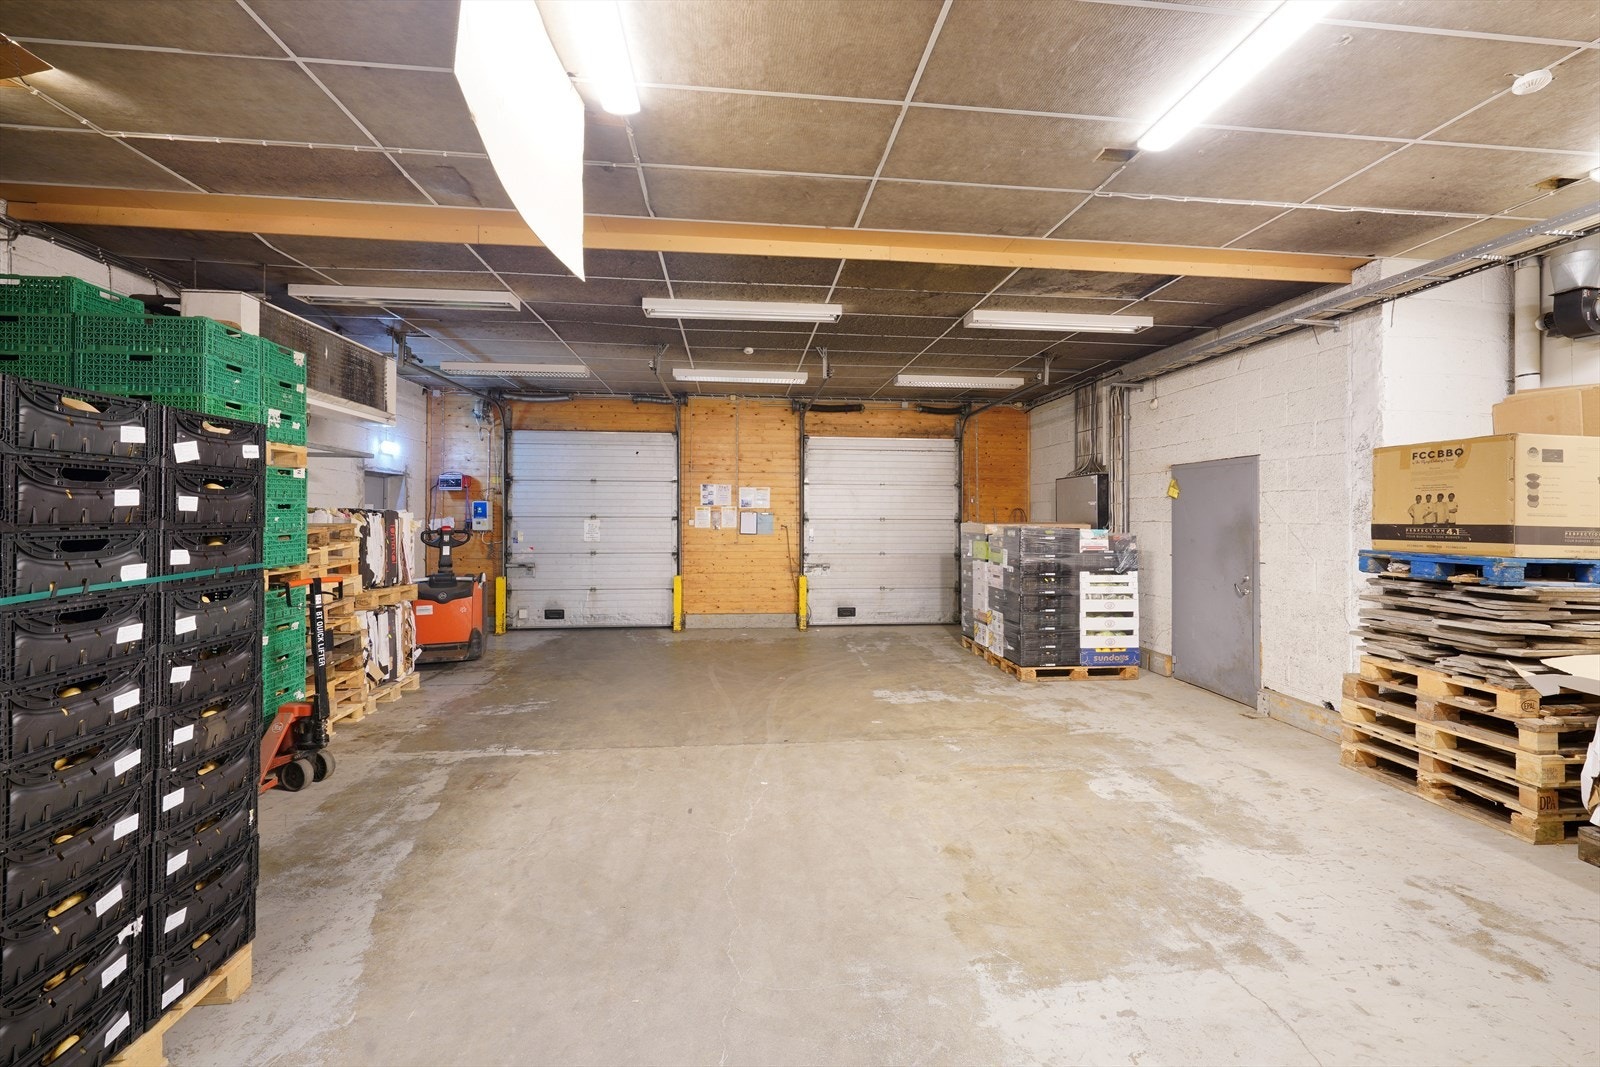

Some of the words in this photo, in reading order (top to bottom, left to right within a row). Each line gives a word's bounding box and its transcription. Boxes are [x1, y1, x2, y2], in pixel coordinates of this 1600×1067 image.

[1412, 448, 1464, 460] FCCBBQ
[316, 611, 323, 620] BT
[316, 621, 325, 643] QUICK
[317, 643, 326, 667] LIFTER
